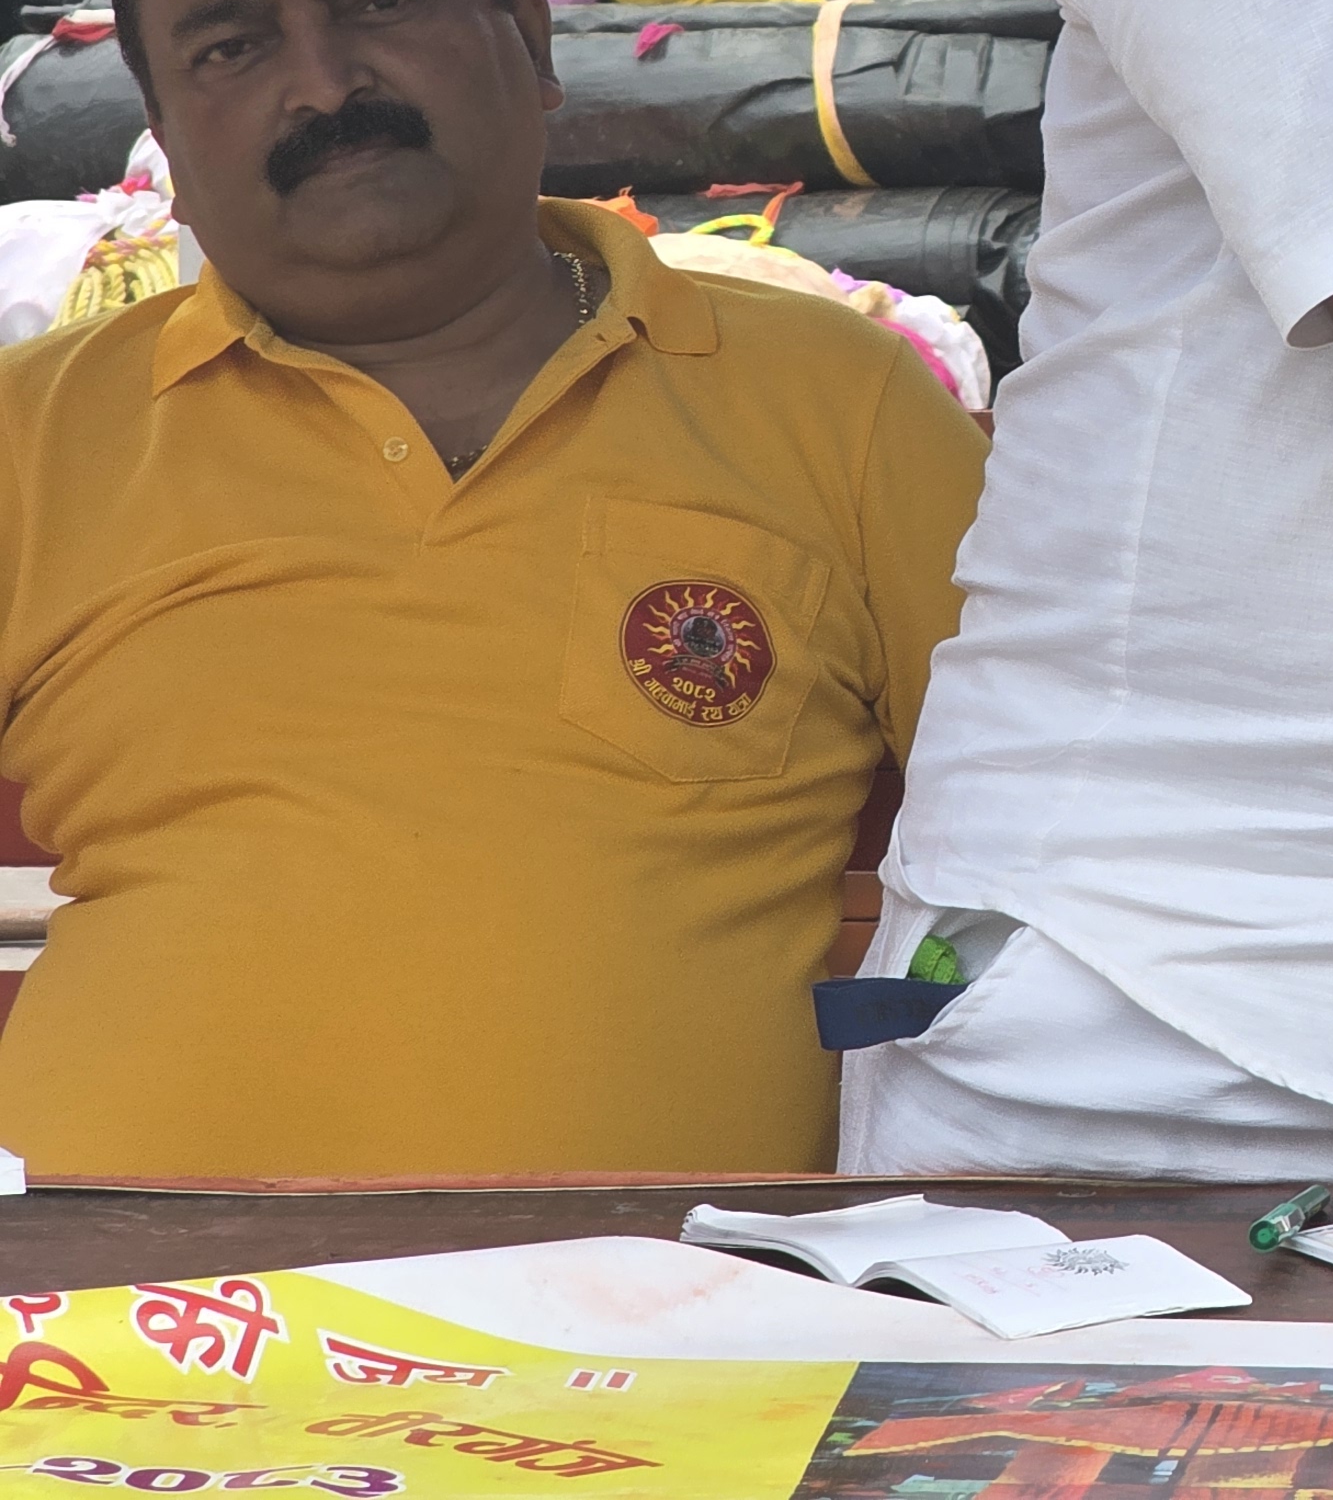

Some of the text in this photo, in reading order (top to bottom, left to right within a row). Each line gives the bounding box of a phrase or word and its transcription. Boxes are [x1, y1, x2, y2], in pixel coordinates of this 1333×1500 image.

[629, 657, 653, 676] श्री
[644, 677, 697, 719] गहवामाई
[701, 705, 724, 721] रथ
[726, 692, 752, 716] यात्रा
[672, 676, 716, 702] २०८२
[132, 1278, 283, 1380] की
[323, 1333, 508, 1388] जय
[304, 1410, 665, 1479] वीरगंज
